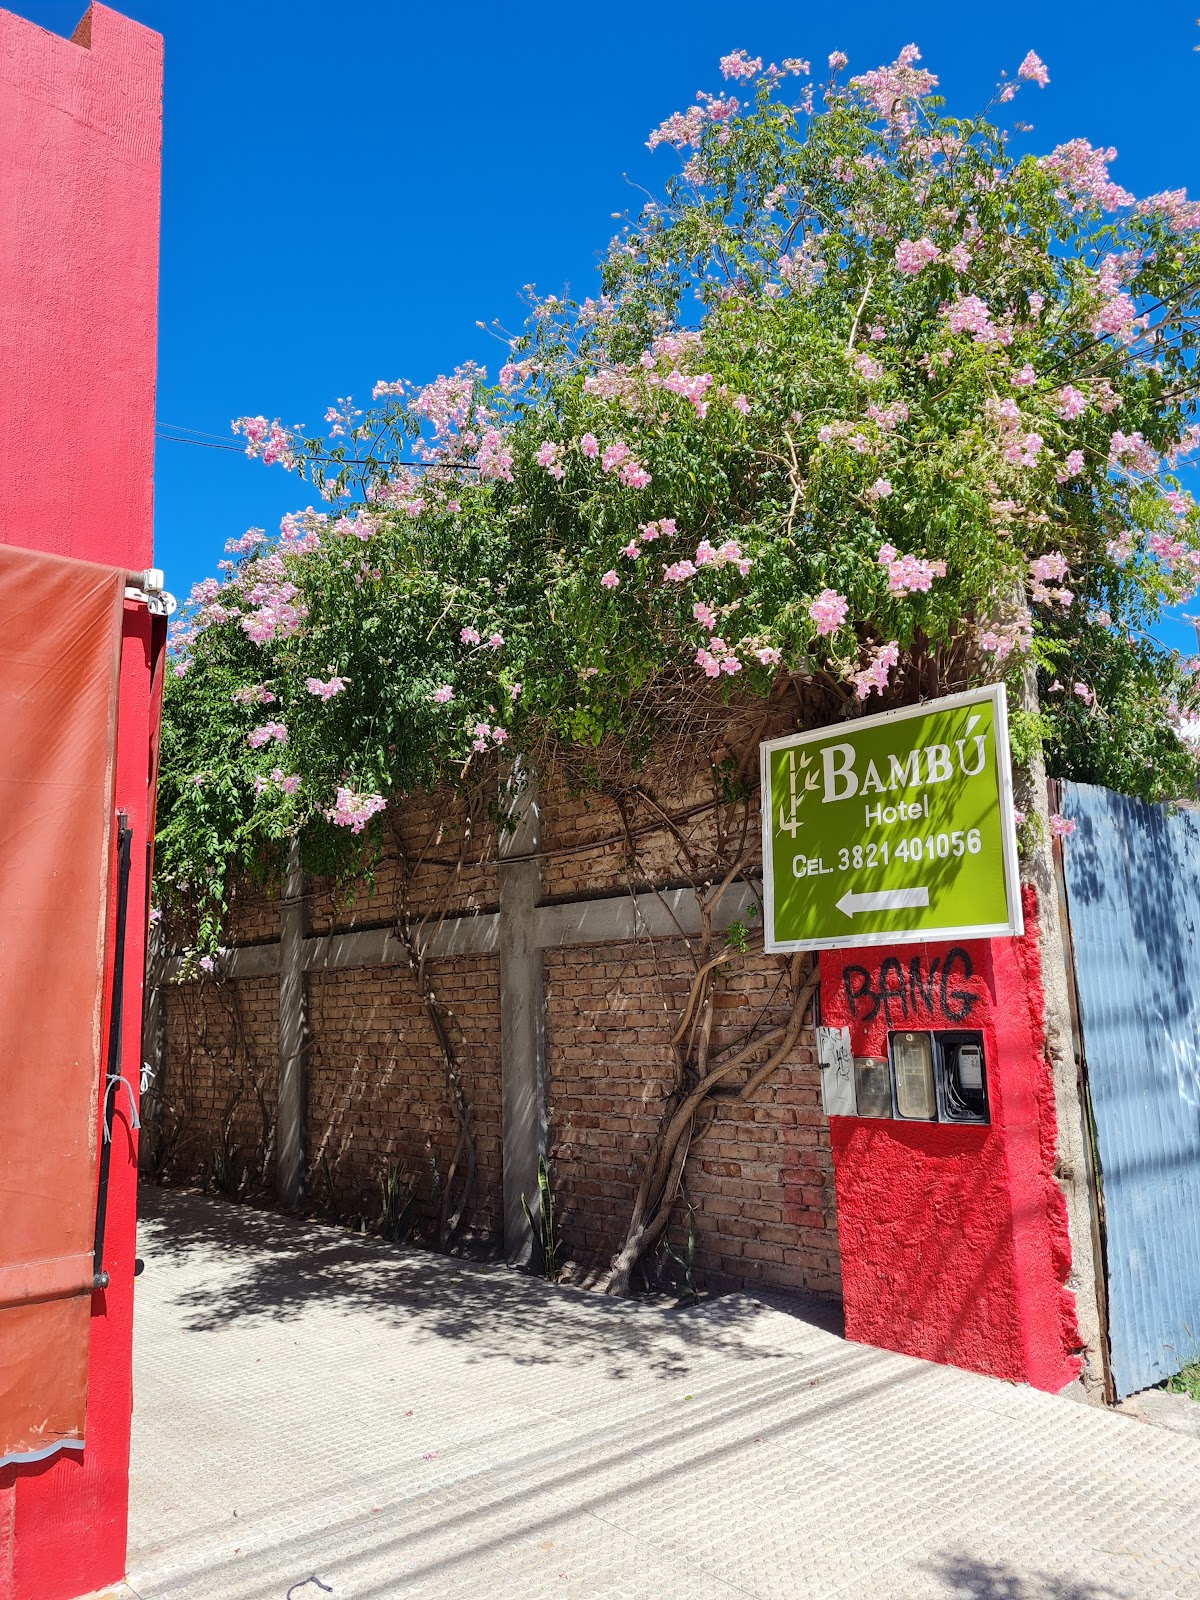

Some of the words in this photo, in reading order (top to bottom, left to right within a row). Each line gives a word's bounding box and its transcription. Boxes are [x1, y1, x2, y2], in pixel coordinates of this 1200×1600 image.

[820, 715, 986, 803] BAMBÚ
[865, 794, 929, 827] Hotel
[842, 947, 979, 1027] BANG
